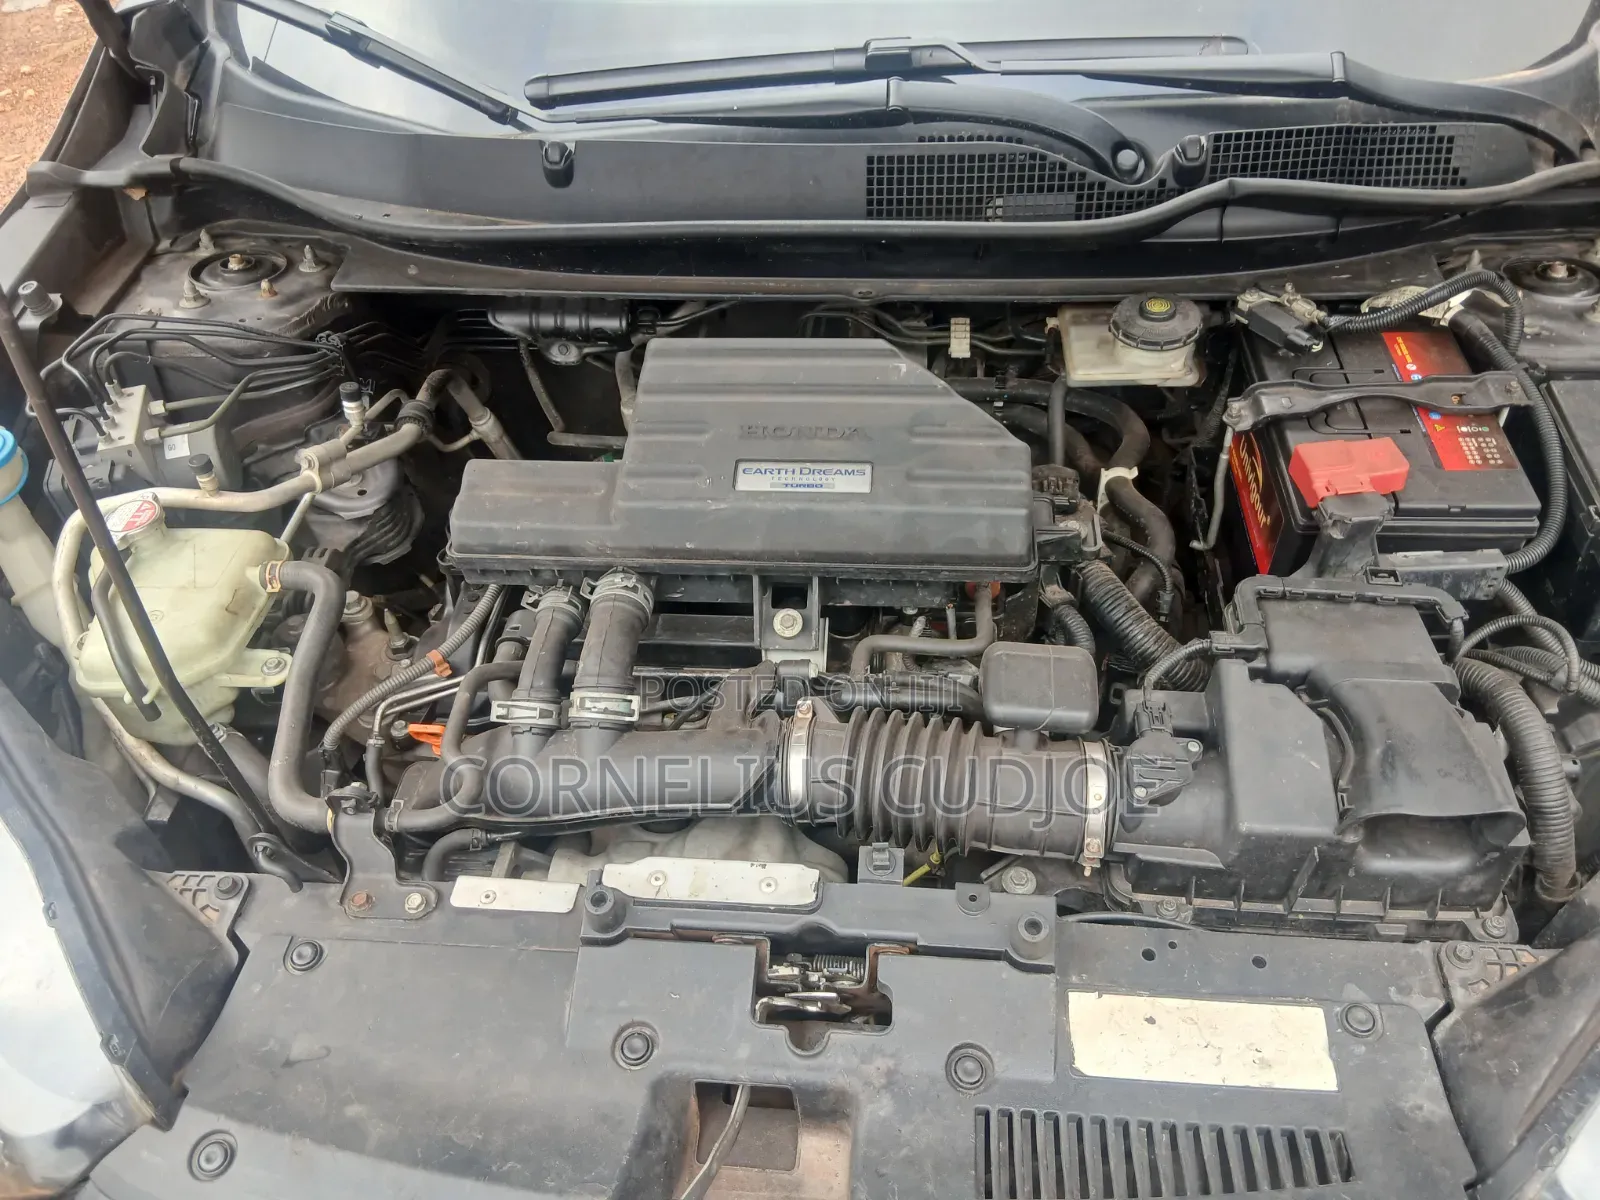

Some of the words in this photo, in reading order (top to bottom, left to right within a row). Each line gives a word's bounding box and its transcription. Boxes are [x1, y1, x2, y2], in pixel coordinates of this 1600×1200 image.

[739, 424, 872, 441] HONDA
[742, 467, 796, 476] EARTH
[799, 467, 866, 476] DREAMS
